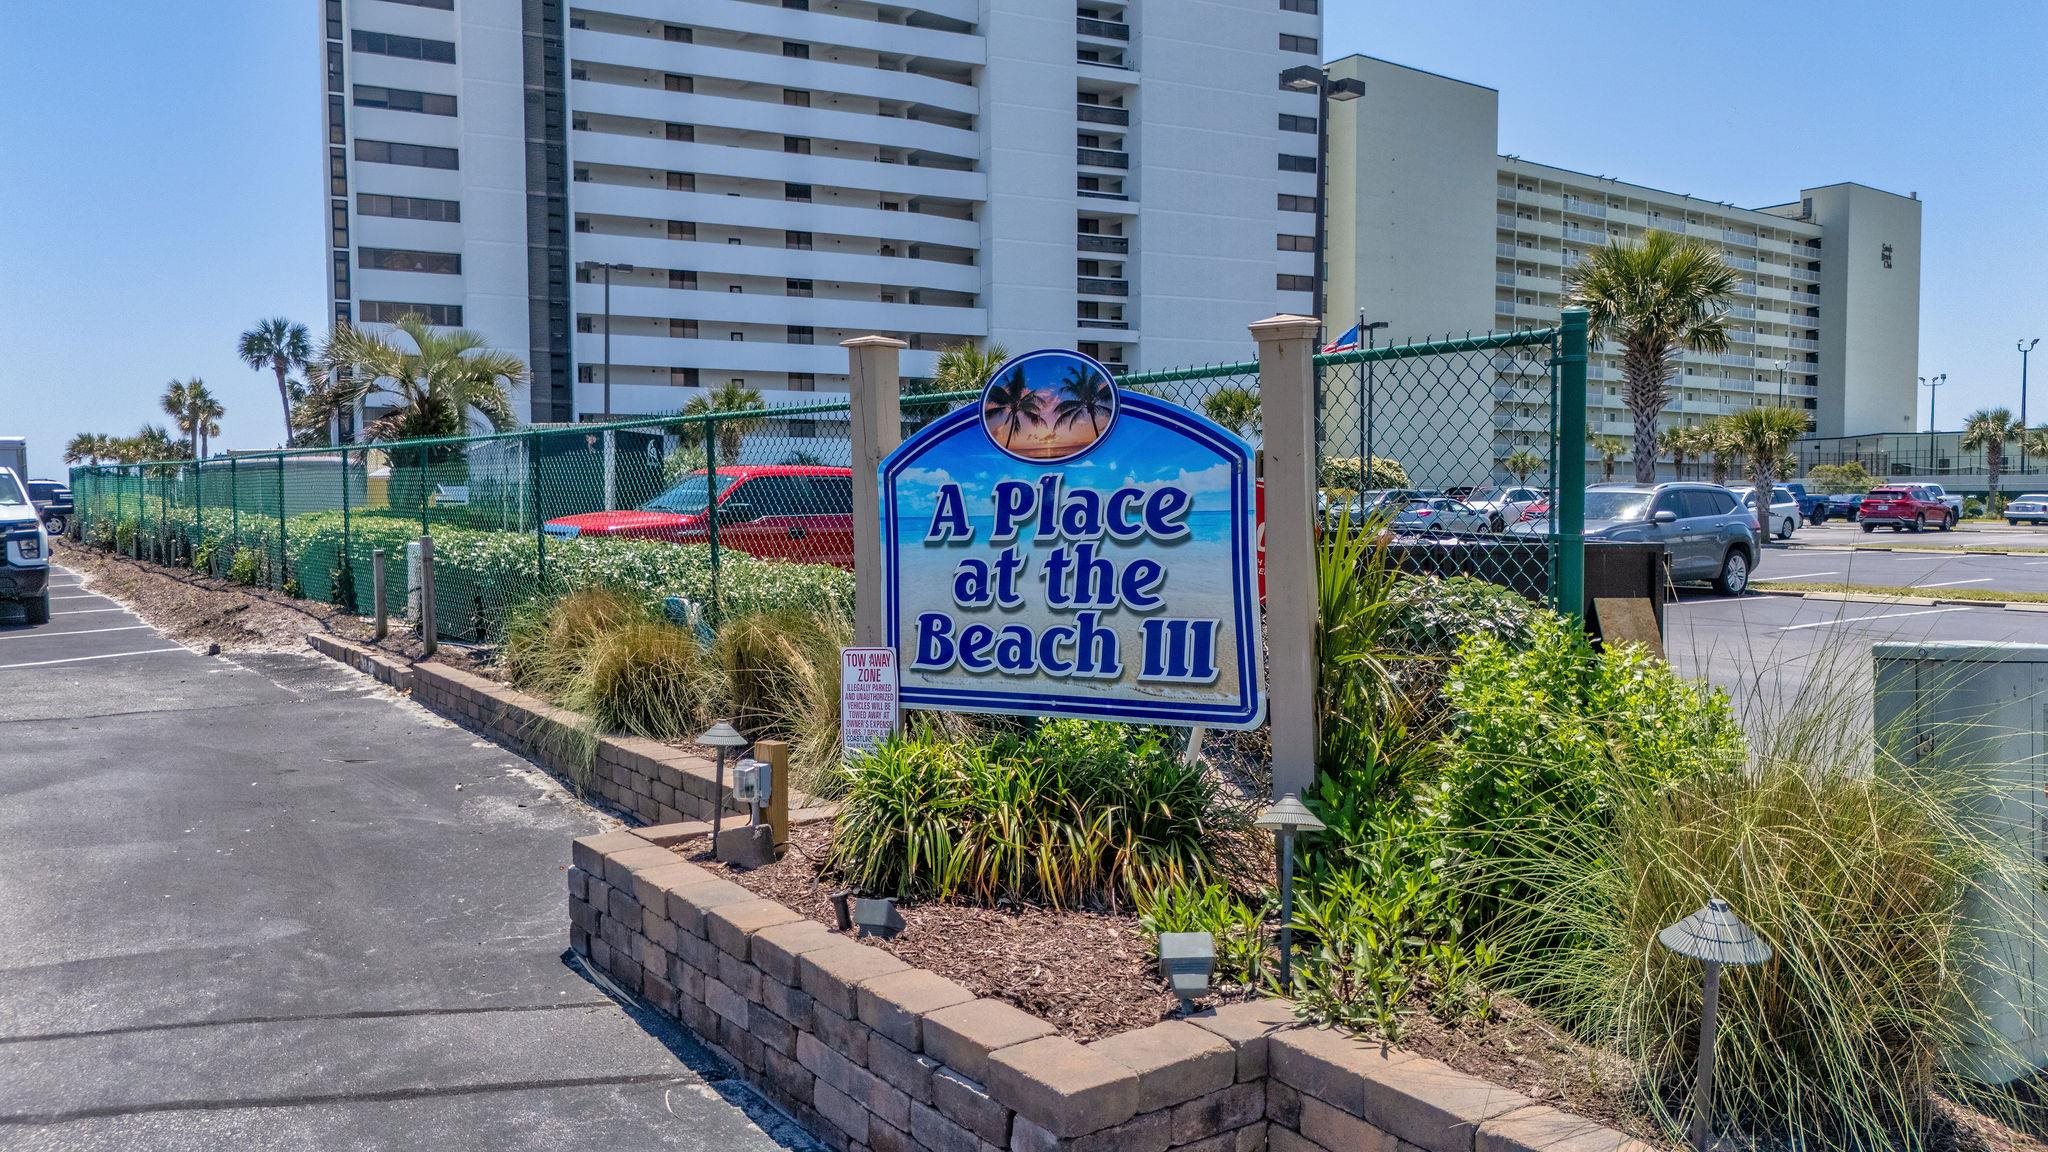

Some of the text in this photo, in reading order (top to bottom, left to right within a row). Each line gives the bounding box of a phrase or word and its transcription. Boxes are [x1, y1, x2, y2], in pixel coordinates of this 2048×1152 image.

[924, 483, 972, 542] A
[990, 473, 1191, 542] Place
[952, 540, 1167, 610] at the
[910, 610, 1220, 682] Beach III
[846, 653, 891, 667] TOW AWAY
[858, 669, 881, 682] ZONE
[872, 684, 892, 692] PARKED
[845, 693, 894, 701] AND UNAUTHORIZED
[847, 702, 891, 710] VEHICLES WILL BE
[849, 711, 867, 719] TOWED
[868, 711, 881, 719] AWAY
